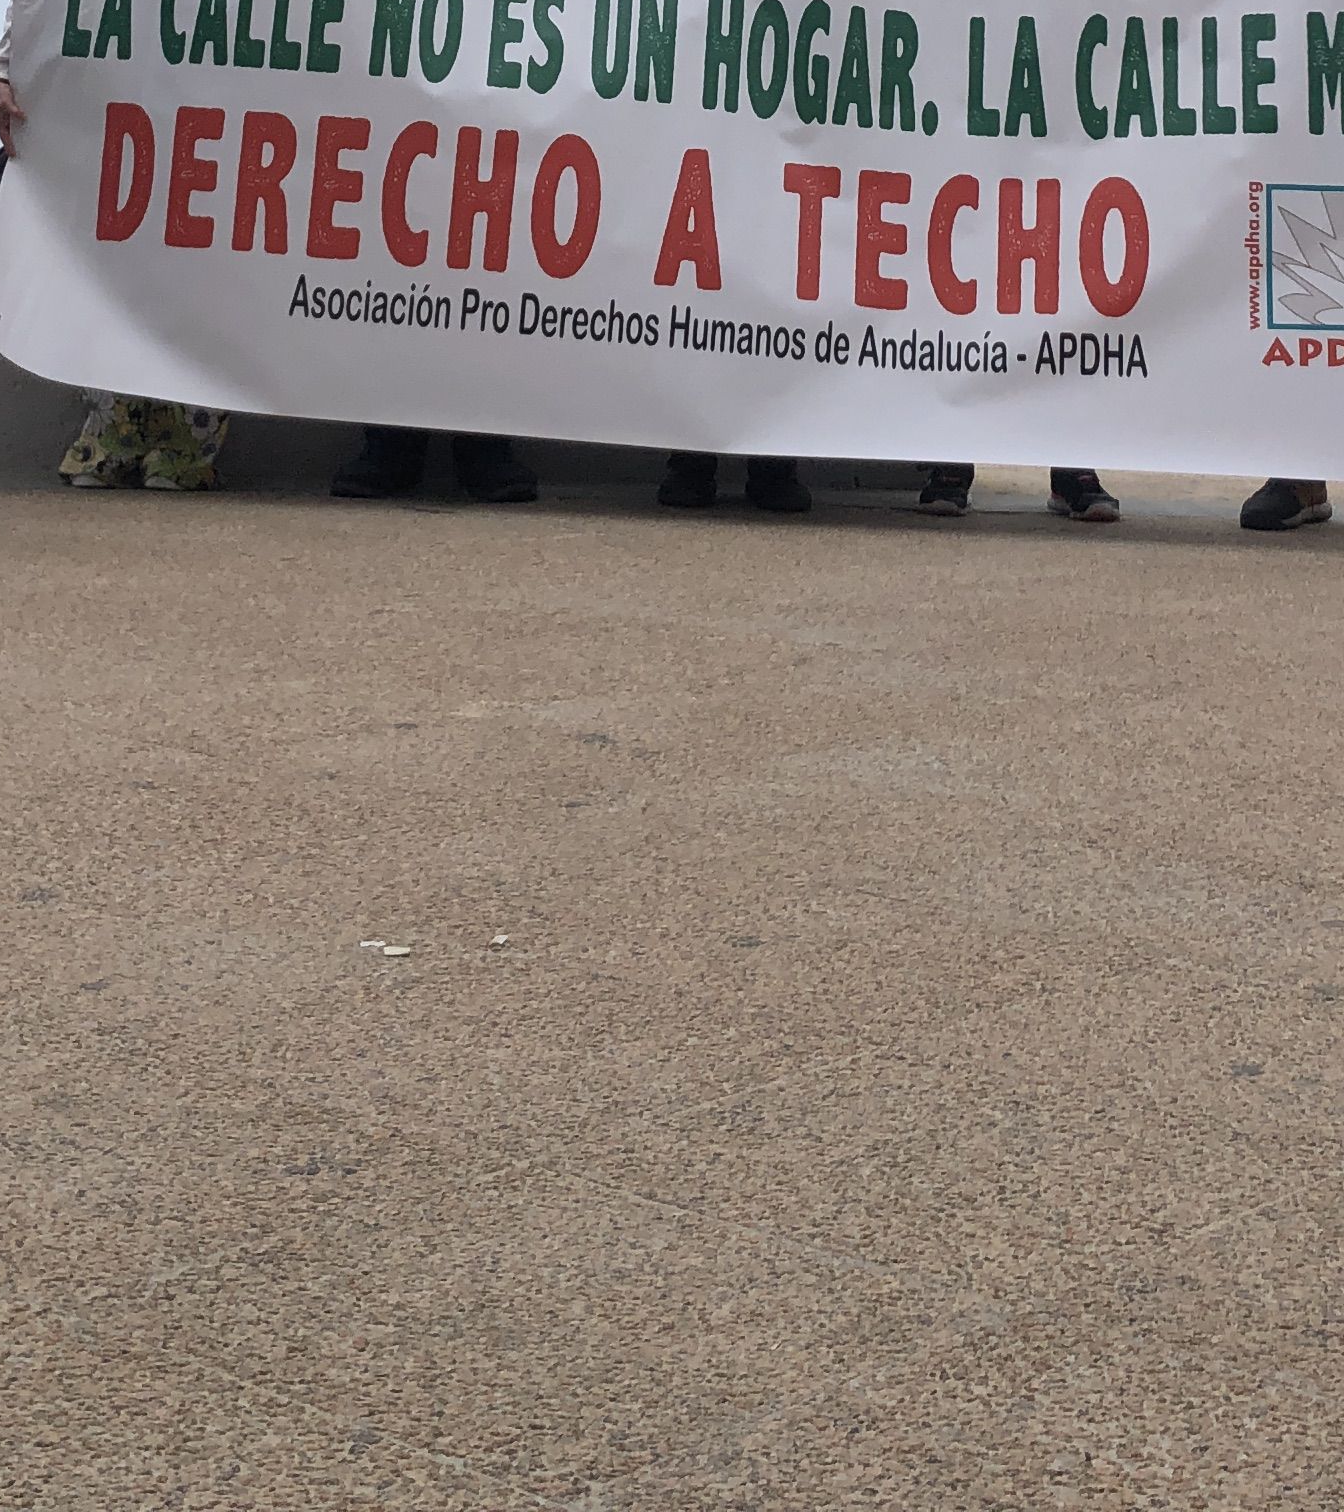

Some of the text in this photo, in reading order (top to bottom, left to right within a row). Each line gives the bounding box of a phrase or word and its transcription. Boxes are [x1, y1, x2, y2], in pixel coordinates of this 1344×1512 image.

[967, 16, 1048, 139] LA
[1075, 13, 1279, 141] CALLE
[96, 102, 1150, 318] DERECHO A TECHO
[1244, 180, 1263, 330] www.apdha.org
[288, 274, 451, 331] Asociación
[460, 287, 511, 335] Pro
[518, 292, 660, 348] Derechos
[668, 304, 807, 362] Humanos
[814, 320, 851, 367] de
[858, 324, 1009, 375] Andalucía
[1034, 330, 1149, 380] APDHA
